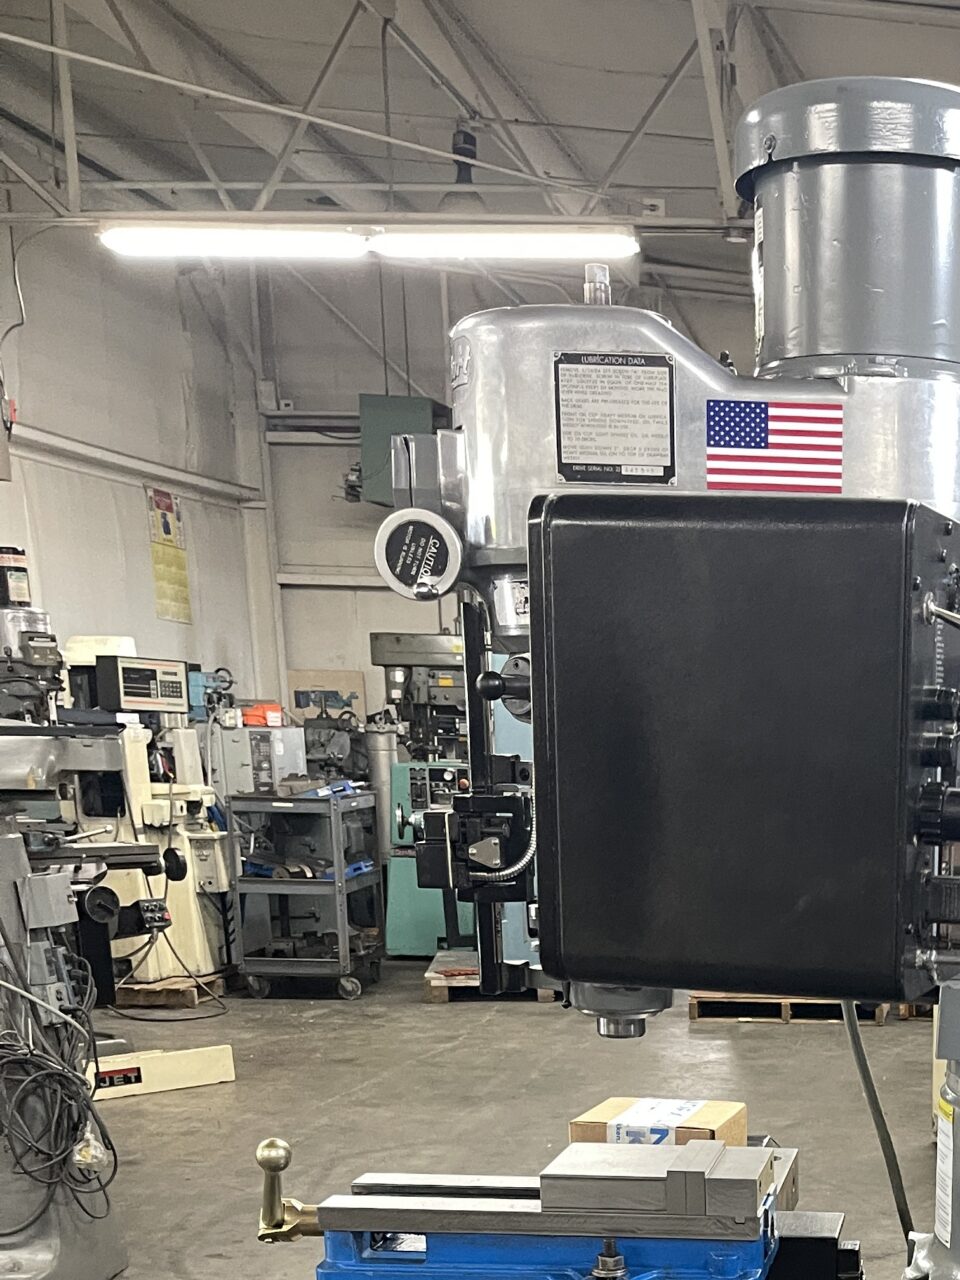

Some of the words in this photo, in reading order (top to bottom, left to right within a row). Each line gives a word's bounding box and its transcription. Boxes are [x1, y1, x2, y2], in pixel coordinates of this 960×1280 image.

[581, 356, 626, 365] LUBRICATION
[628, 357, 646, 365] DATA
[100, 1073, 139, 1087] JET
